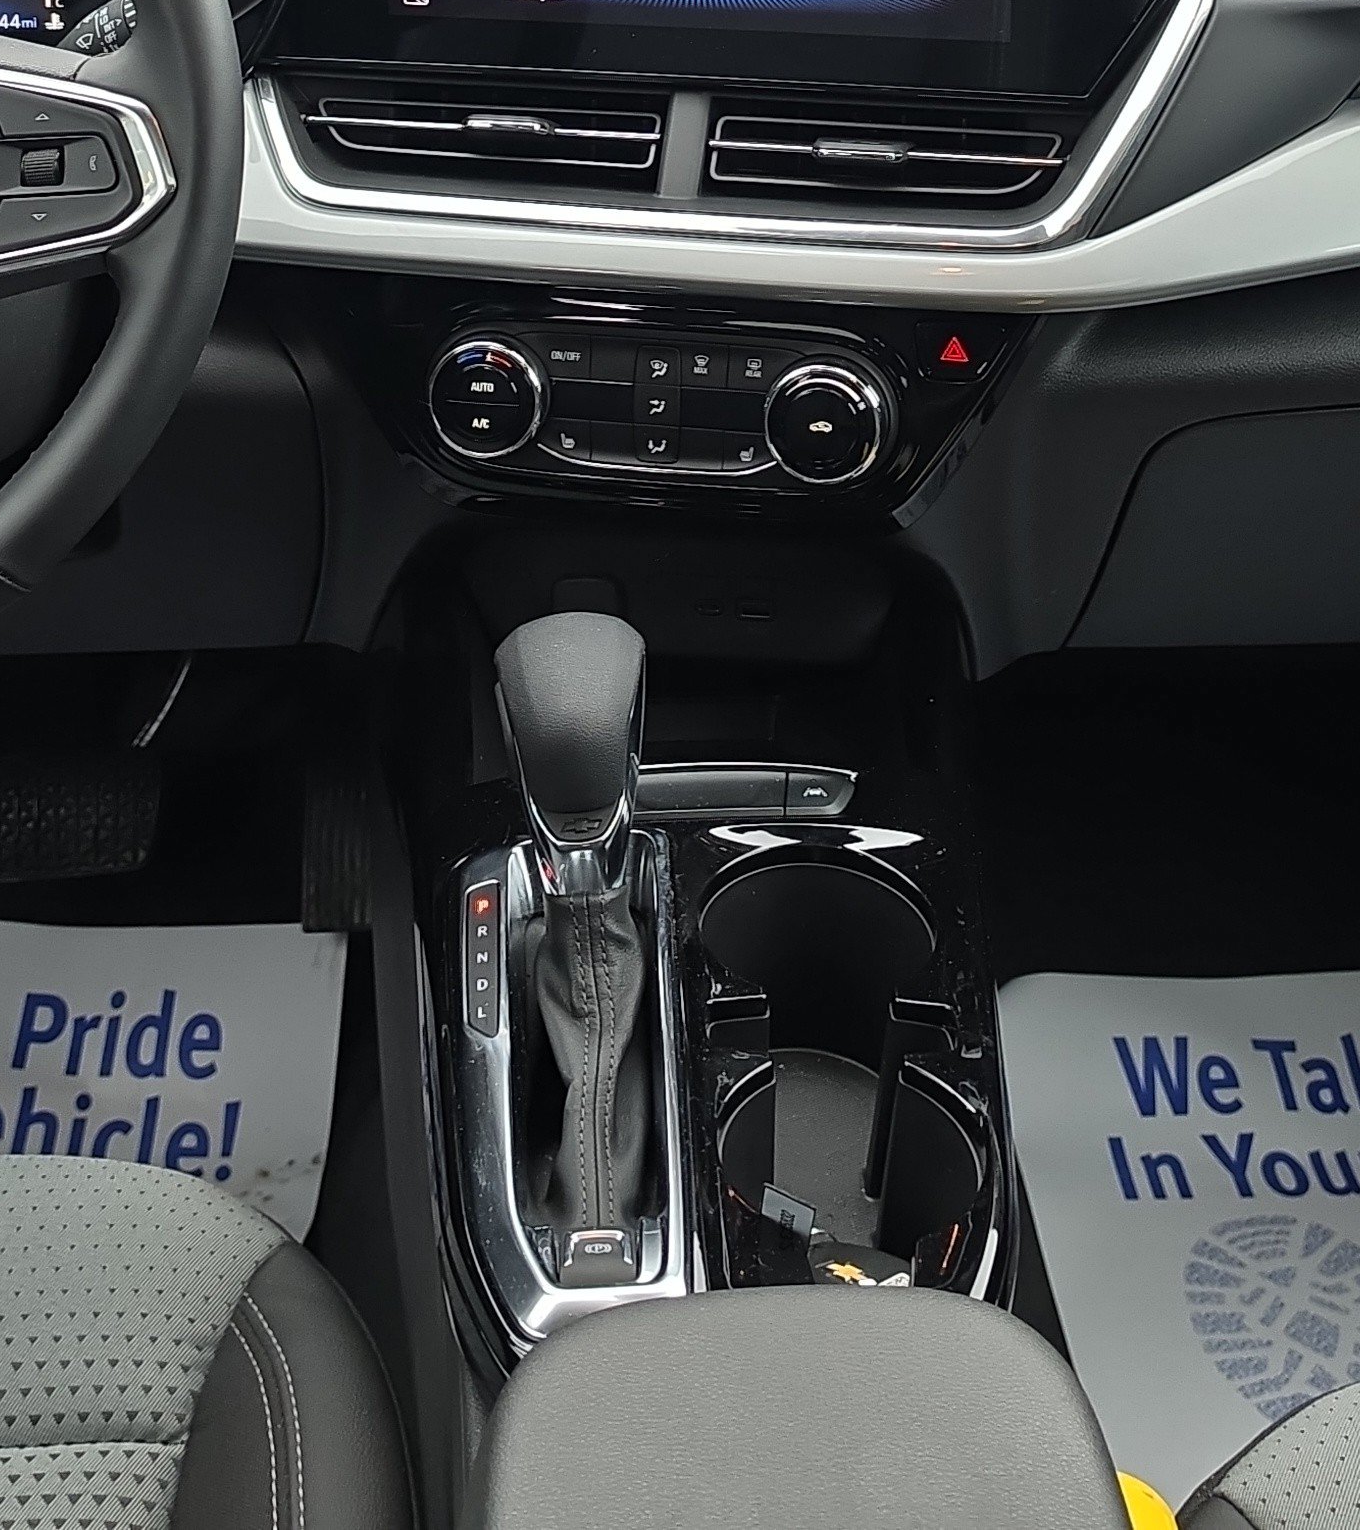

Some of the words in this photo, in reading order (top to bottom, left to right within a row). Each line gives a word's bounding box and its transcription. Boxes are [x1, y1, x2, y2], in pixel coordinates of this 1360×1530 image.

[104, 32, 118, 44] OFF
[550, 350, 582, 361] ON/OFF
[693, 366, 708, 375] MAX
[744, 369, 762, 378] REAR
[470, 381, 495, 393] AUTO
[472, 418, 490, 429] A/C
[477, 899, 489, 913] P
[477, 925, 488, 937] R
[476, 951, 488, 963] N
[476, 978, 488, 991] D
[477, 1006, 487, 1018] L
[11, 988, 223, 1081] Pride
[1112, 1034, 1243, 1118] We
[1108, 1134, 1195, 1201] In
